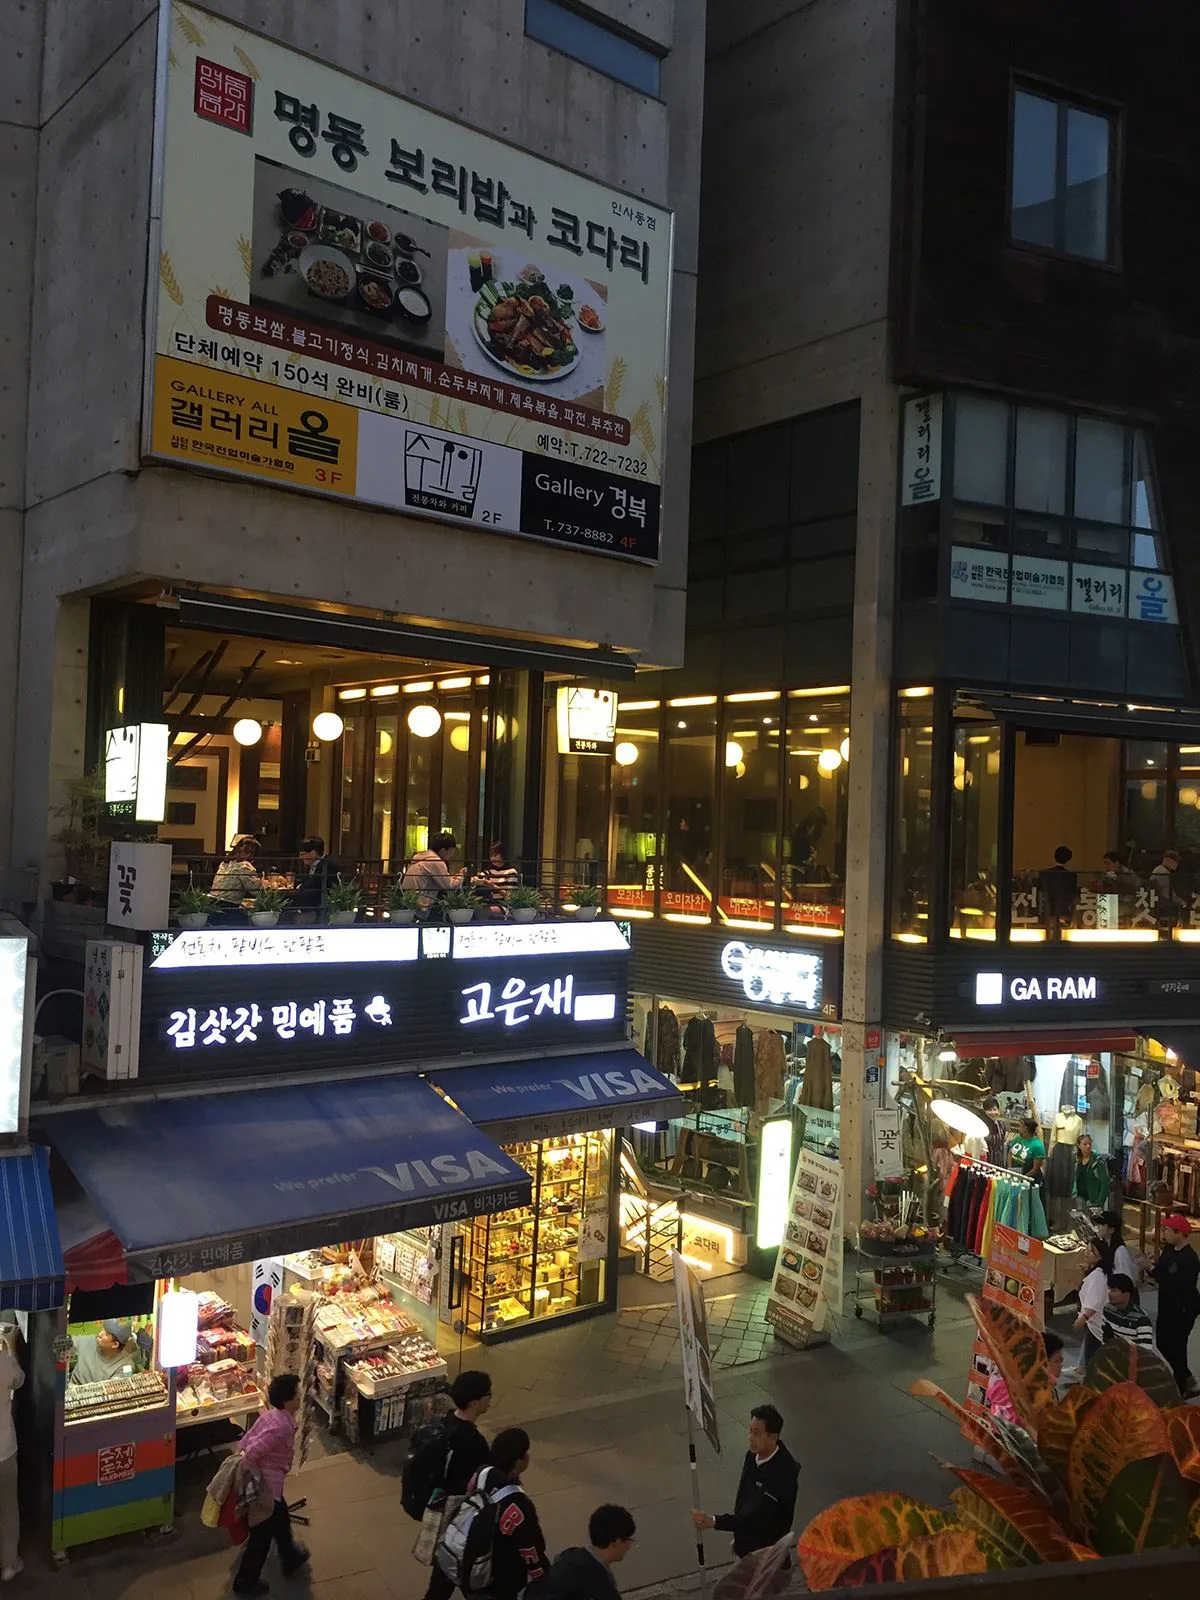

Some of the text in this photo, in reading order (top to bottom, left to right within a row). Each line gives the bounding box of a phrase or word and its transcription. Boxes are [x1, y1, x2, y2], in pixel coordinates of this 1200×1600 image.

[275, 90, 650, 283] 명동 보리밥과 코다리
[612, 201, 656, 231] 인사동점
[175, 331, 408, 413] 단체예약 150석 완비(룸)
[170, 380, 279, 416] GALLERY ALL
[170, 398, 278, 449] 갤러리
[315, 468, 343, 485] 3F
[535, 473, 647, 528] Gallery 경북
[482, 510, 502, 524] 2F
[544, 519, 637, 549] T.737-8882 4F
[1076, 577, 1122, 604] 갤러리
[665, 893, 705, 911] 오미자차
[459, 975, 575, 1026] 고은재
[1010, 976, 1097, 1000] GA RAM
[167, 998, 356, 1047] 김삿갓 민예품
[822, 1003, 836, 1015] 4F
[551, 1068, 667, 1101] VISA
[878, 1129, 896, 1150] 꽃
[271, 1150, 511, 1193] We prefer VISA
[433, 1190, 520, 1220] VISA 비자카드
[150, 1241, 244, 1276] 김삿갓 민예품
[694, 1236, 720, 1254] 코다리
